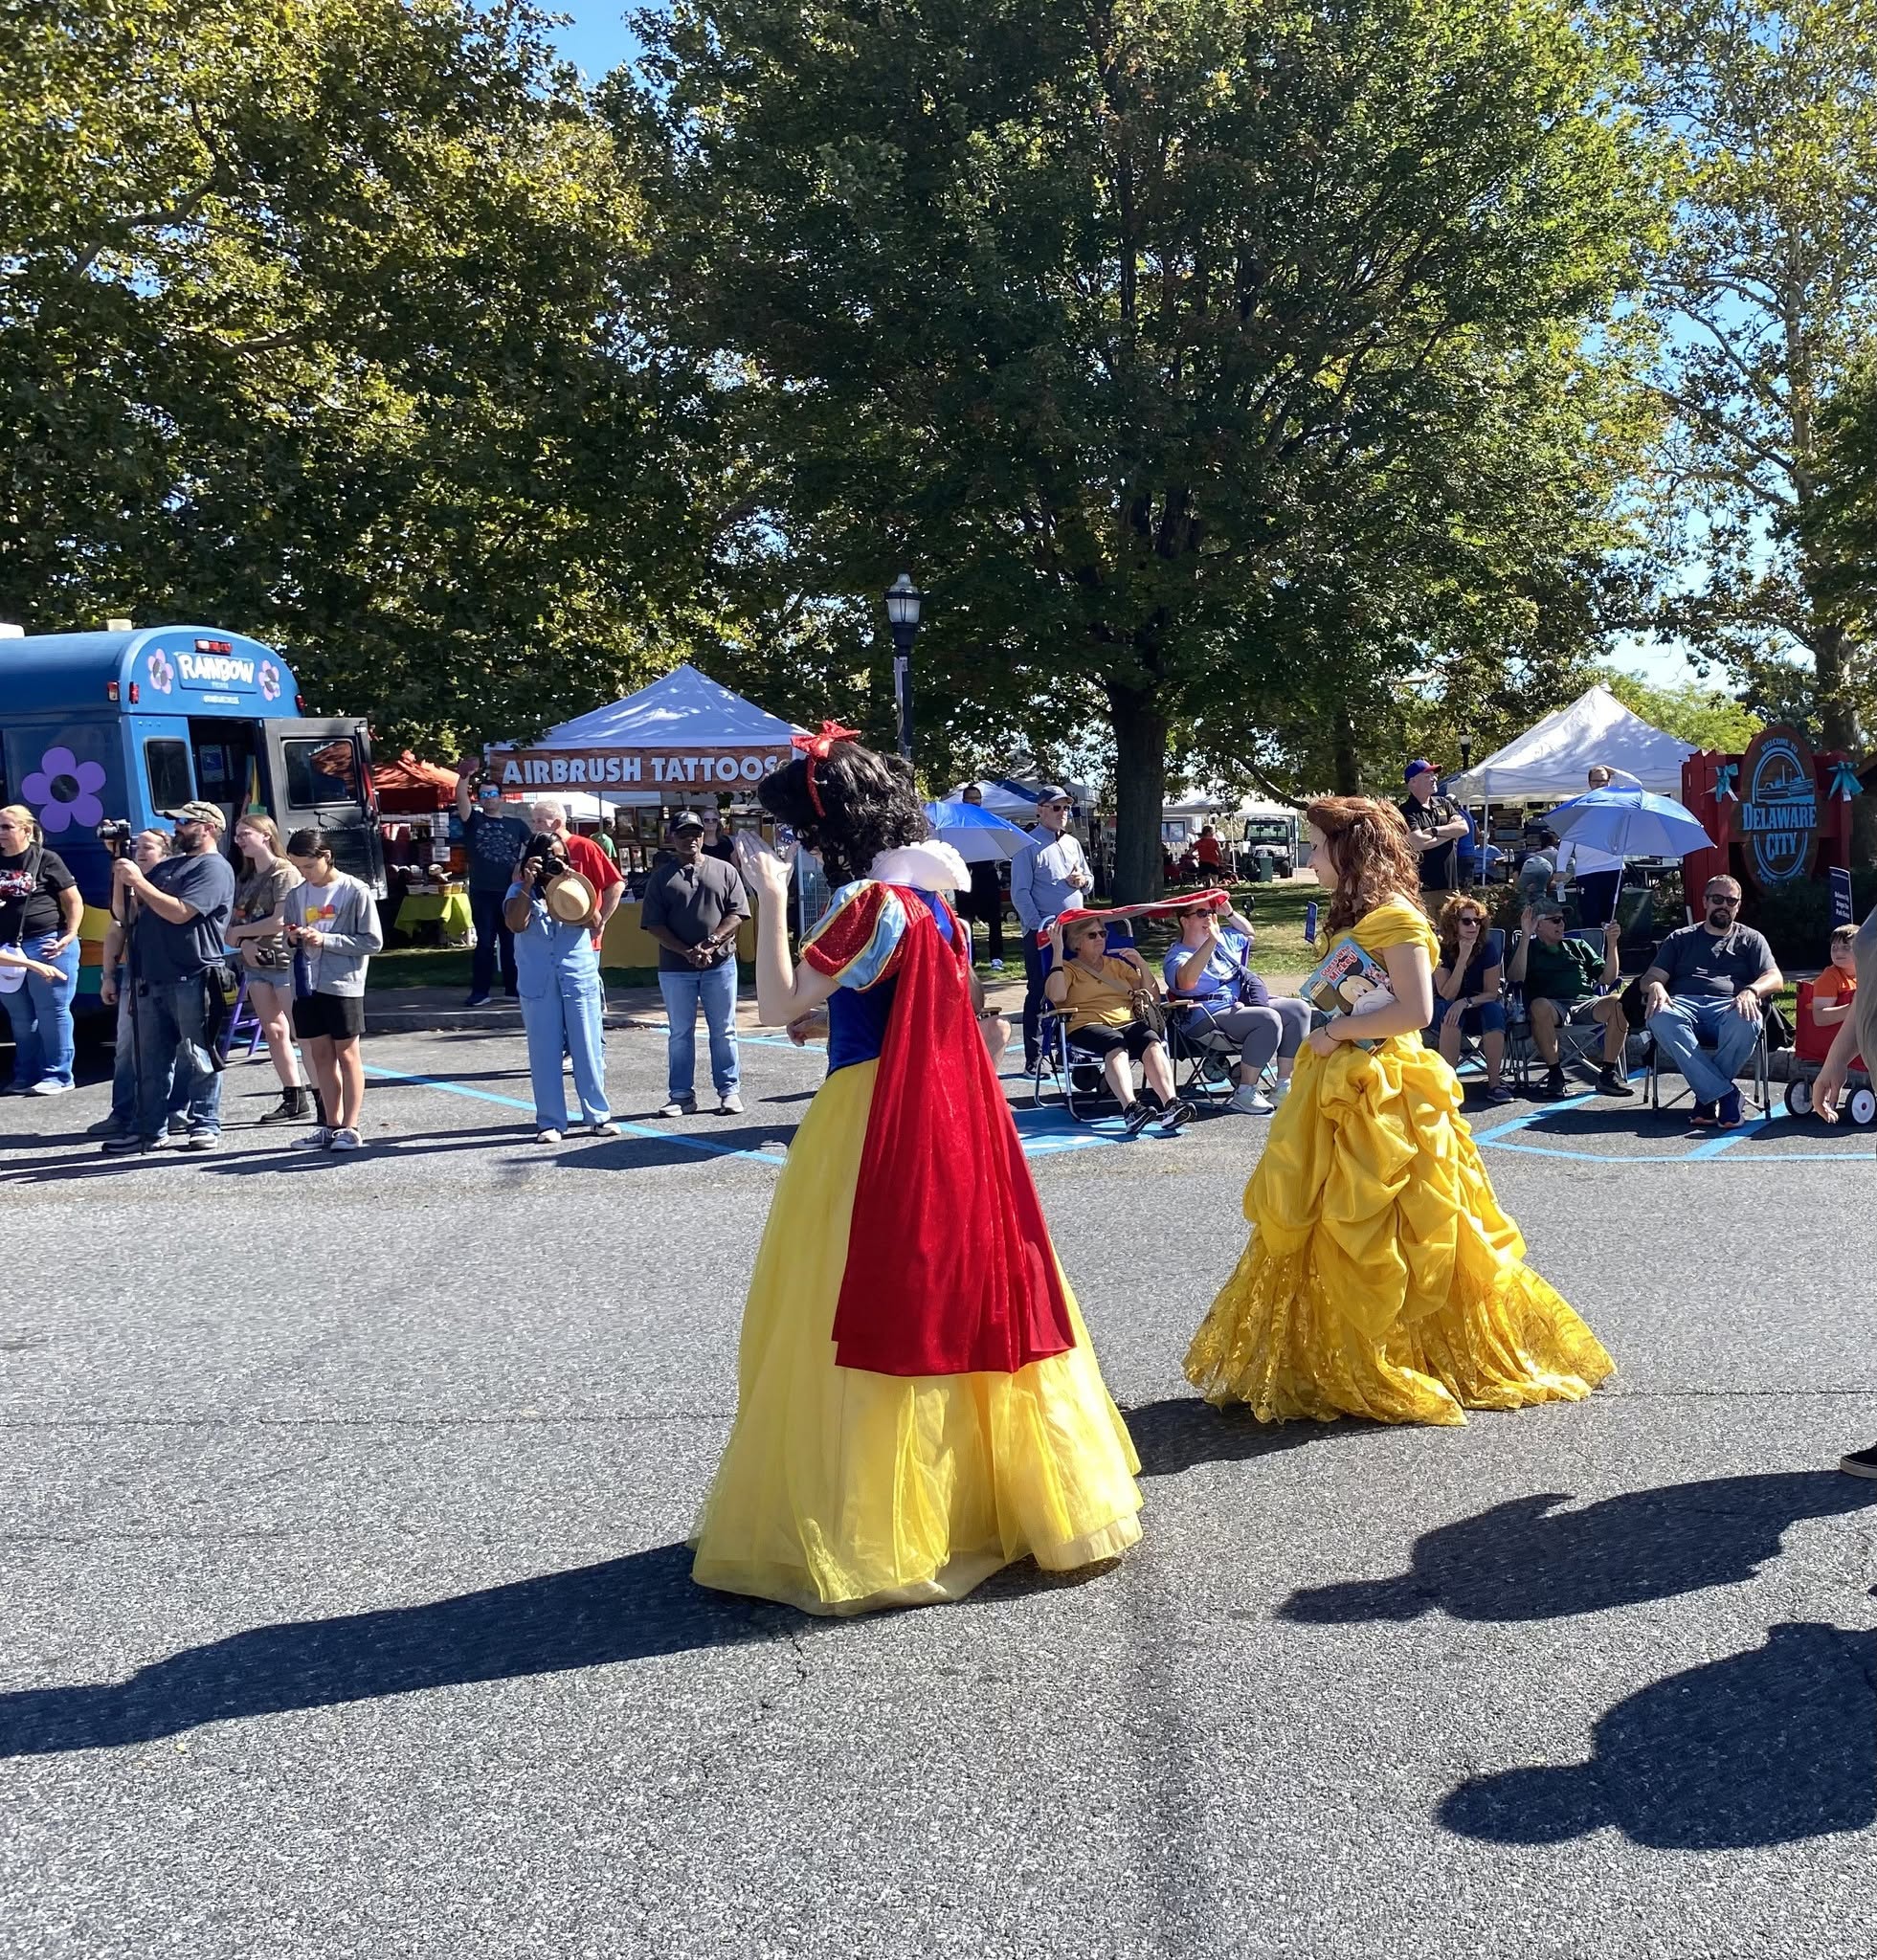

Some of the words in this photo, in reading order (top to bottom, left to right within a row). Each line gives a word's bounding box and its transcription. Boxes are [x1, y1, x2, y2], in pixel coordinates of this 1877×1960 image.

[178, 655, 255, 683] RAINBOW
[503, 757, 641, 784] AIRBRUSH
[651, 756, 777, 782] TATTOOS
[1743, 803, 1817, 831] DELAWARE
[1766, 832, 1798, 860] CITY
[1320, 958, 1338, 976] Guess
[1330, 948, 1357, 982] Mickey!
